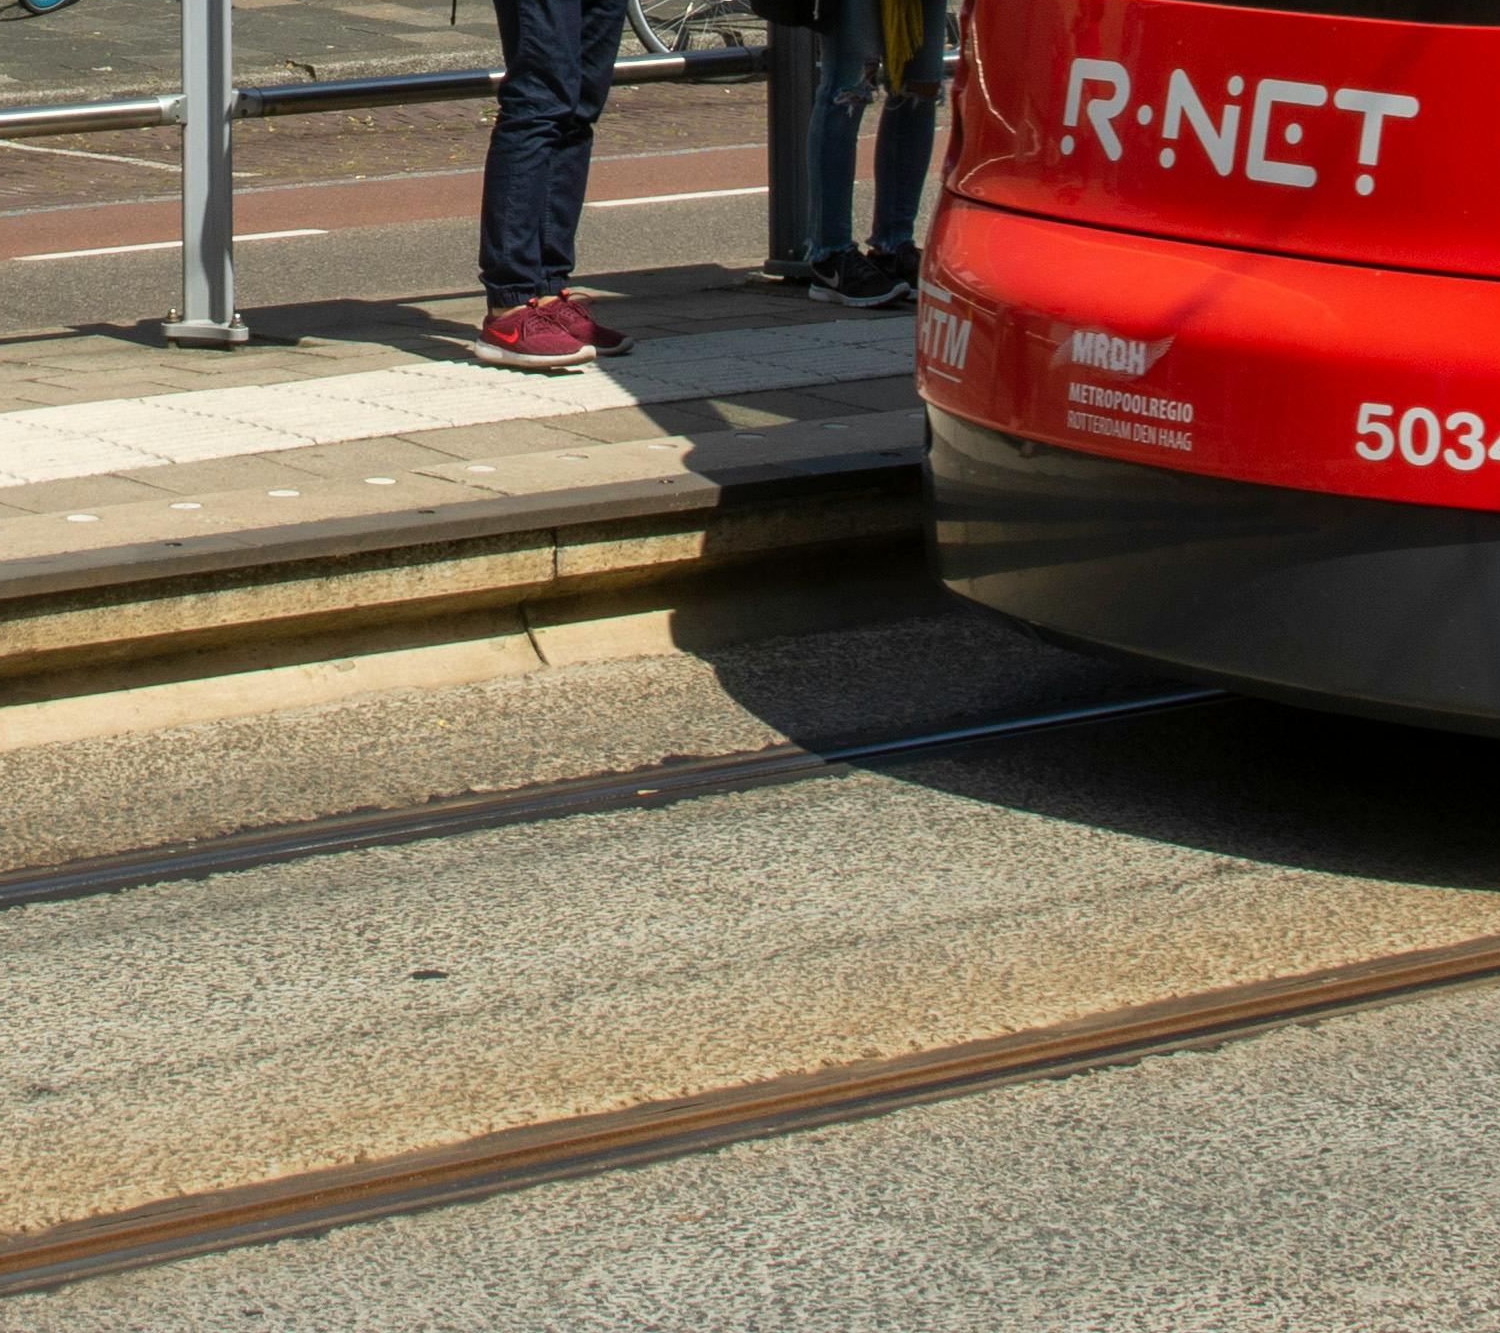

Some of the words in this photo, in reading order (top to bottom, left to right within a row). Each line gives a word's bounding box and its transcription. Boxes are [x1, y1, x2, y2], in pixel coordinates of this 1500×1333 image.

[920, 303, 972, 370] HTM
[1072, 330, 1146, 375] MRDH
[1068, 382, 1194, 424] METROPOOLREGIO
[1067, 410, 1132, 440] ROTTERDAM
[1133, 423, 1157, 445] DEN
[1158, 428, 1193, 452] HAAG
